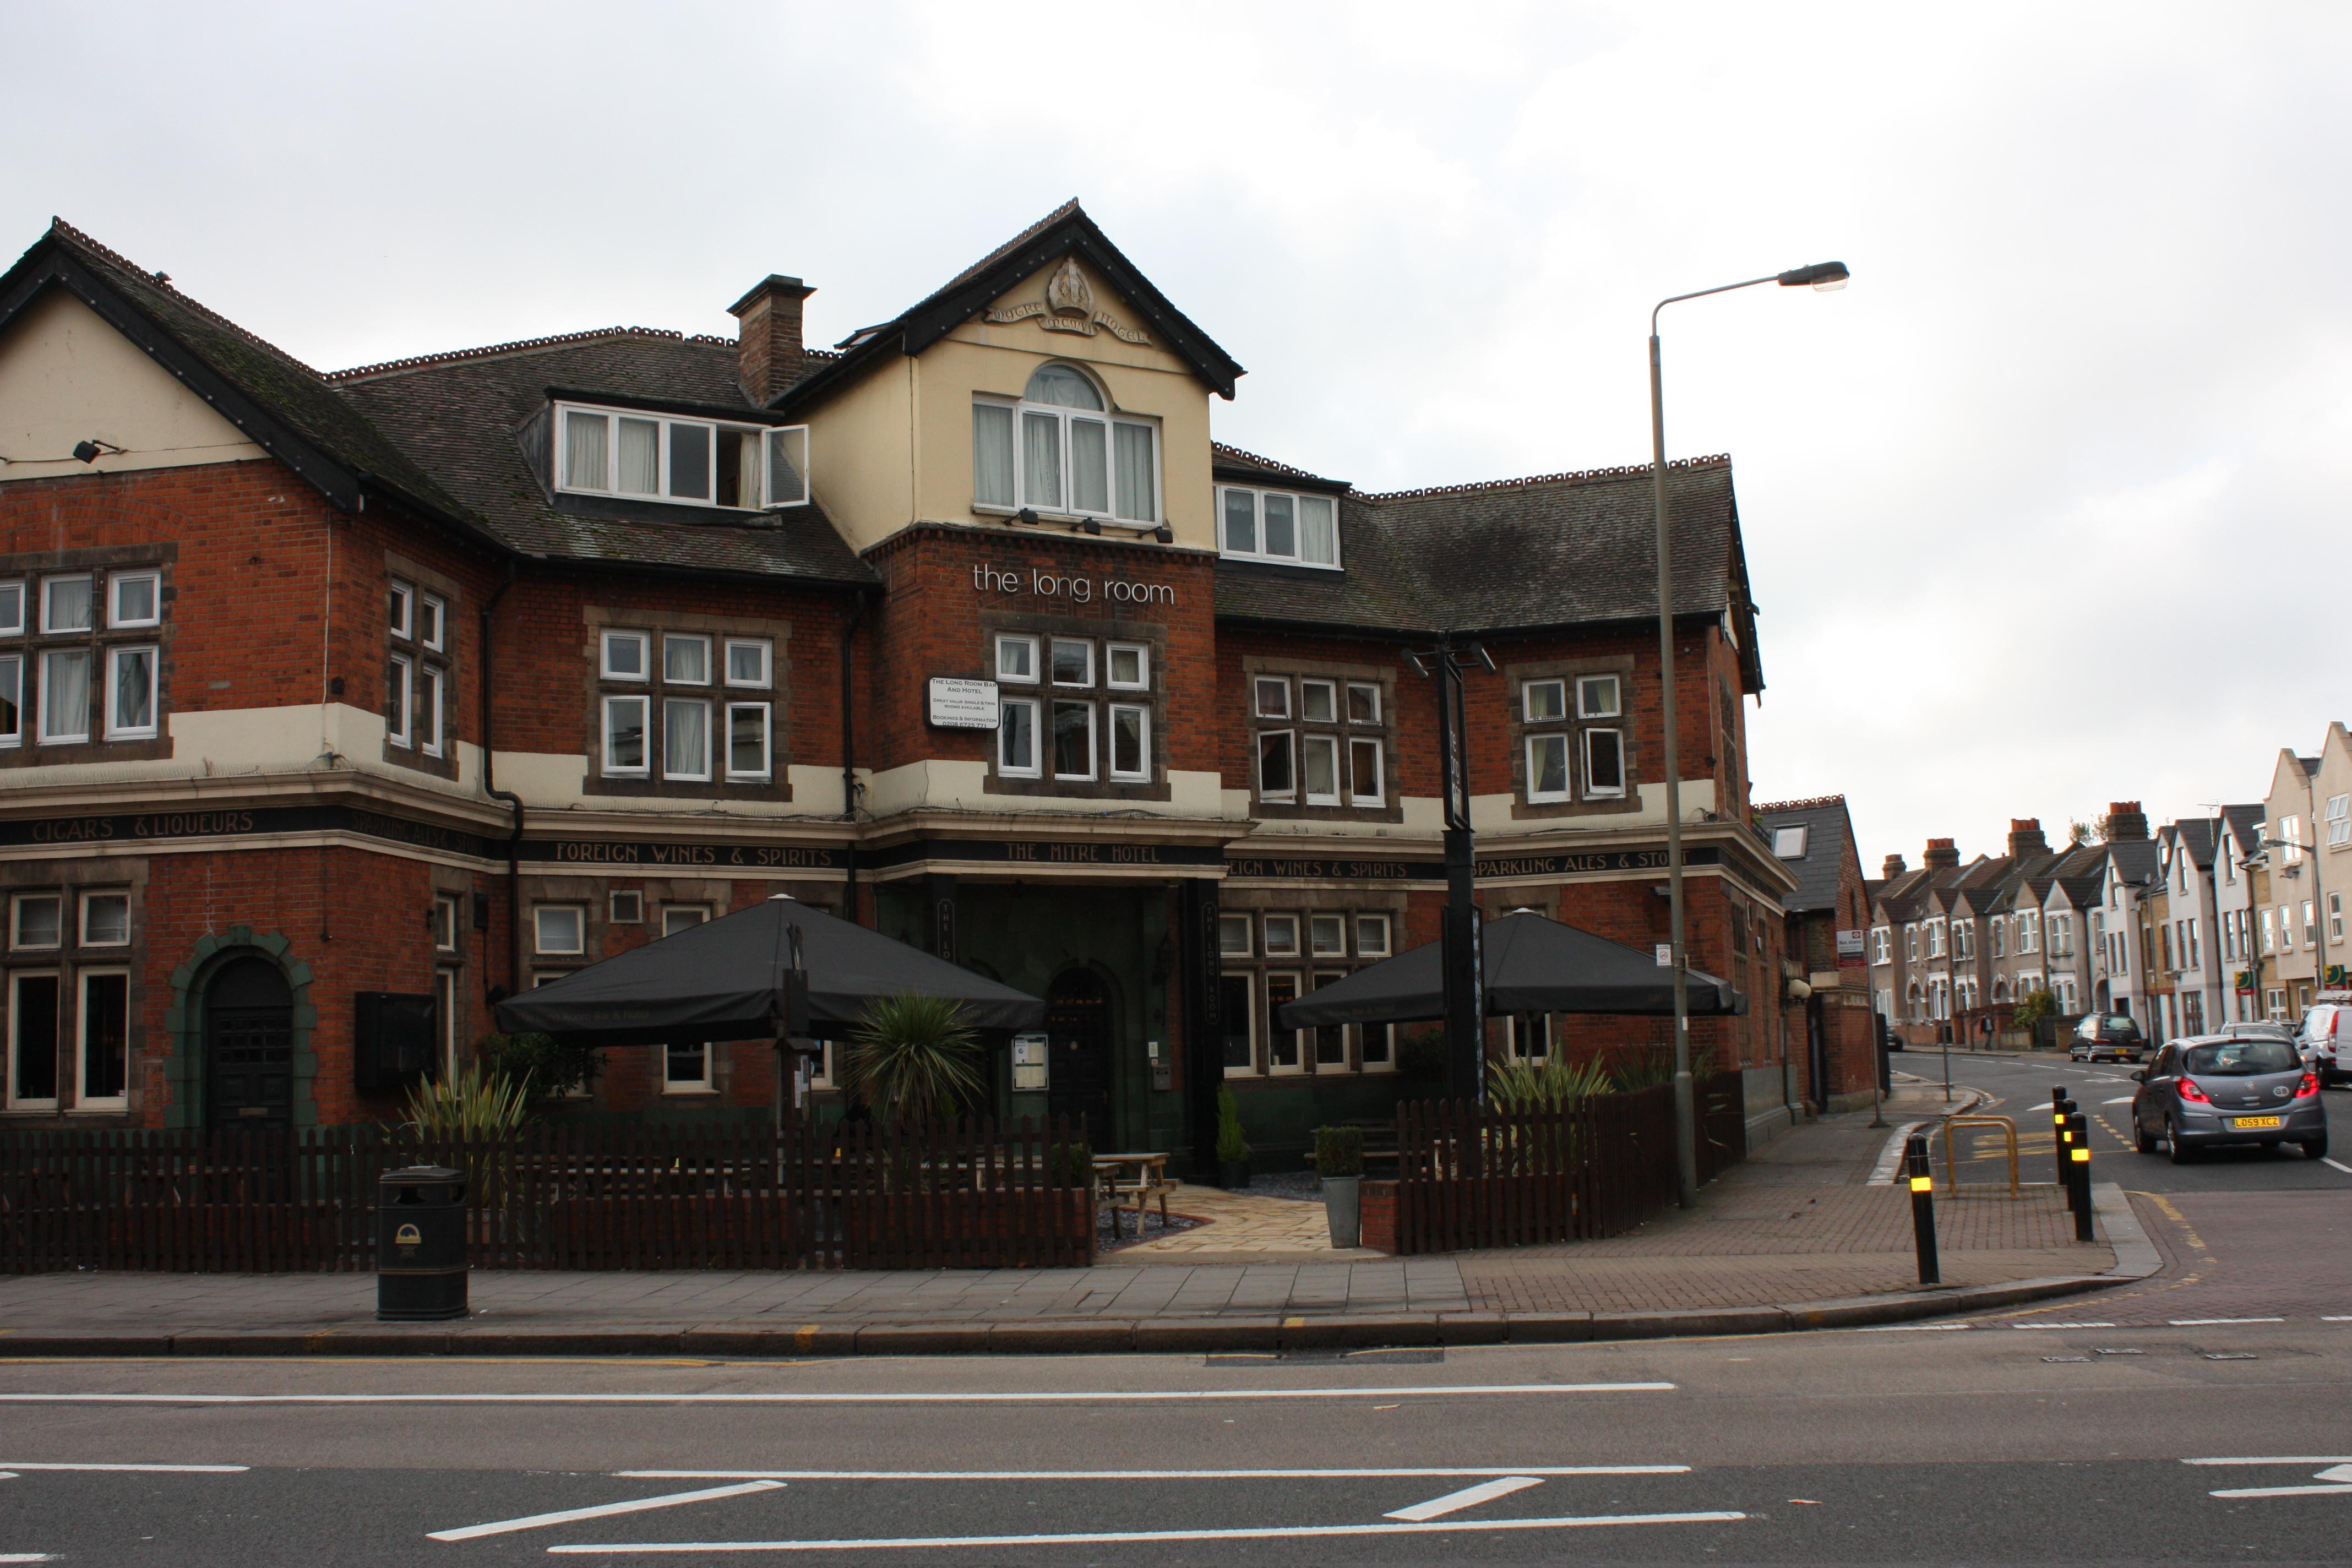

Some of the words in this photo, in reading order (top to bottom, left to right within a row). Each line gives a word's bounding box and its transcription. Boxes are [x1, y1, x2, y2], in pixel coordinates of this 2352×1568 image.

[974, 563, 1018, 592] the
[1033, 568, 1090, 602] long
[1104, 581, 1174, 605] room
[32, 818, 114, 841] CIGARS
[134, 816, 149, 836] &
[153, 810, 253, 835] LIQUEURS
[556, 843, 639, 862] FOREIGN
[651, 846, 715, 863] WINES
[731, 848, 743, 864] &
[757, 848, 832, 867] SPIRITS
[1005, 842, 1036, 859] THE
[1050, 844, 1099, 861] MITRE
[1112, 846, 1159, 862] HOTEL
[1473, 857, 1554, 876] SPARKLING
[1564, 854, 1607, 872] ALES
[1619, 853, 1629, 868] &
[1638, 850, 1690, 867] STOT
[1273, 860, 1322, 876] WINES
[1332, 862, 1342, 876] &
[1350, 862, 1406, 878] SPIRITS
[2261, 1117, 2278, 1125] XCZ
